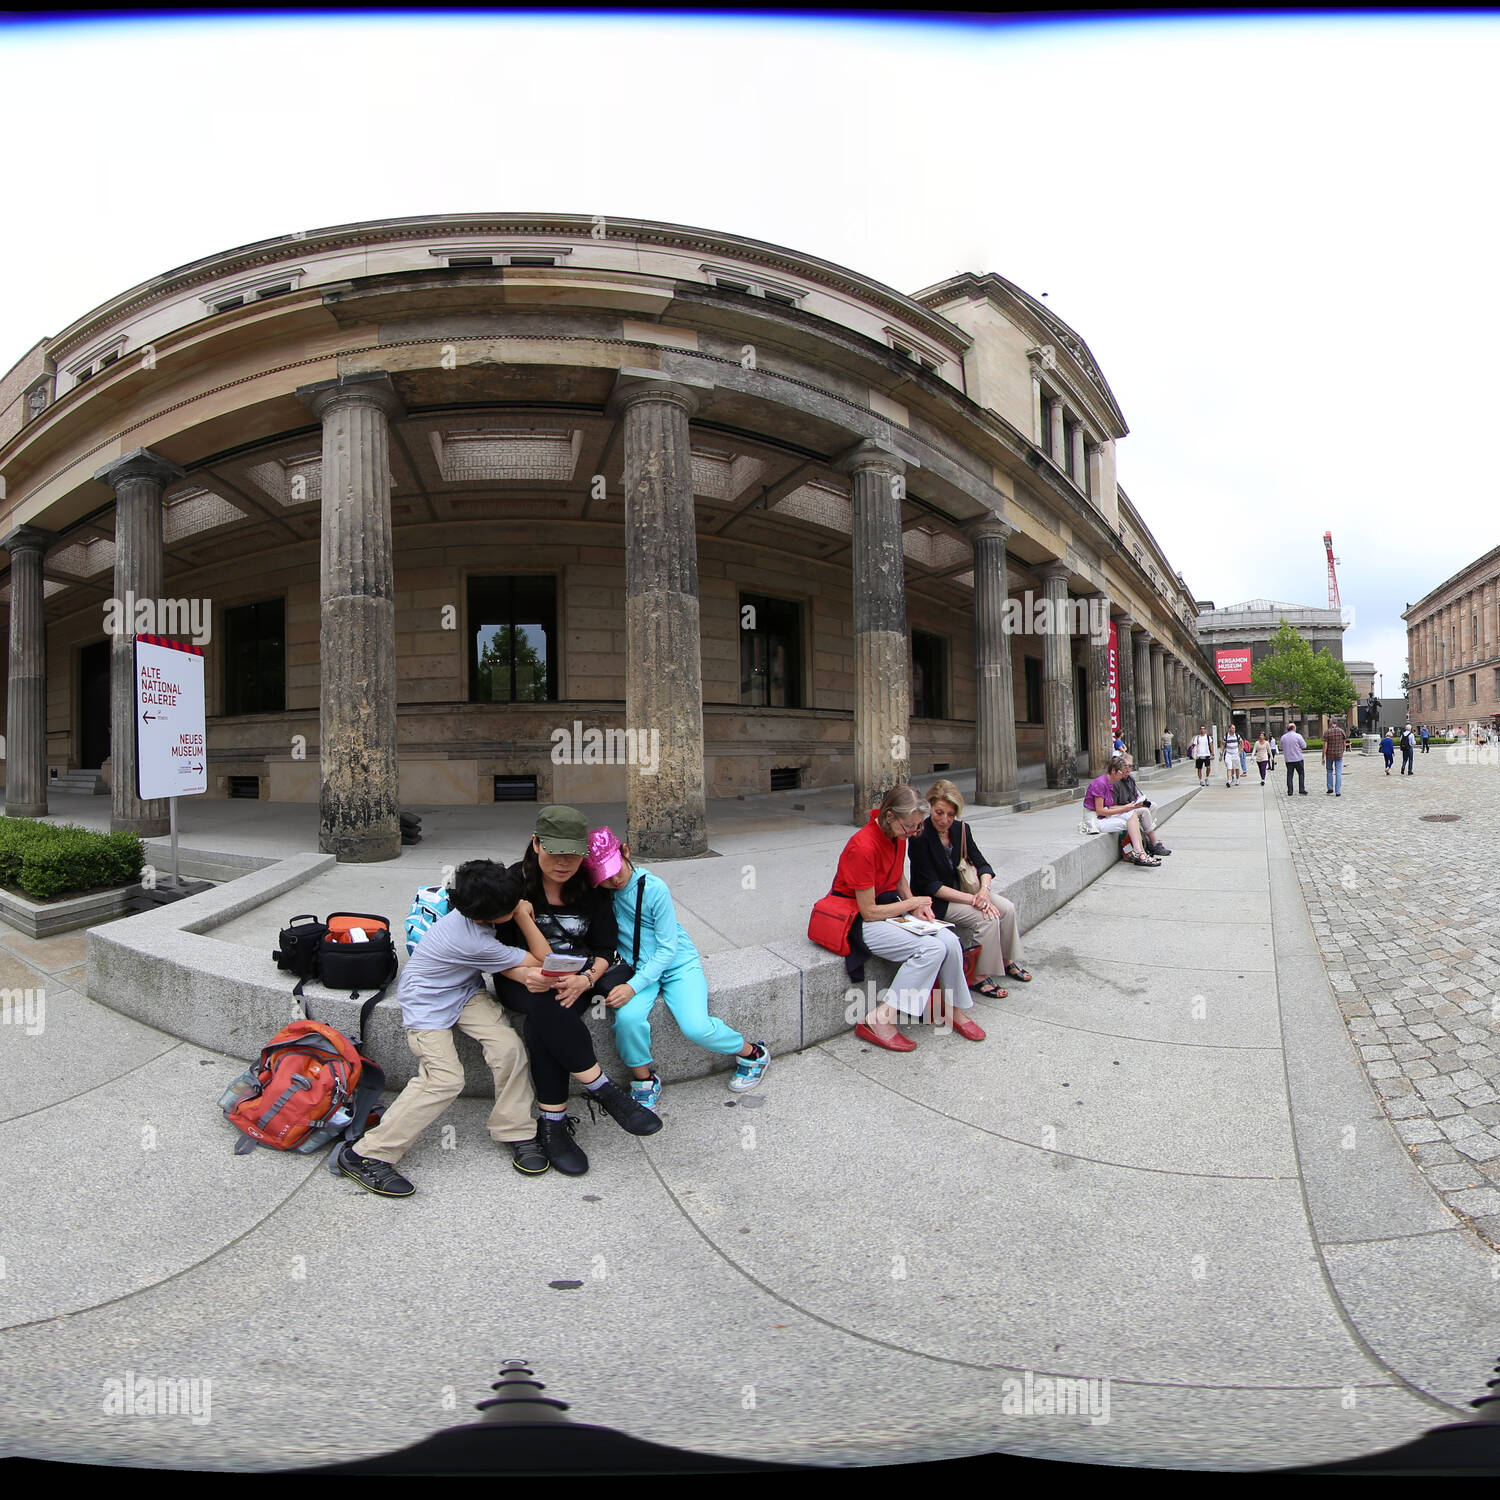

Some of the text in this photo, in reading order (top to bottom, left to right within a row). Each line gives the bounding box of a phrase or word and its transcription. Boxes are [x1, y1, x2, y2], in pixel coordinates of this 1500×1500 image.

[141, 665, 161, 680] ALTE
[141, 678, 183, 695] NATIONAL
[141, 691, 177, 706] GALERIE
[179, 733, 203, 745] NEUES
[171, 745, 204, 757] MUSEUM
